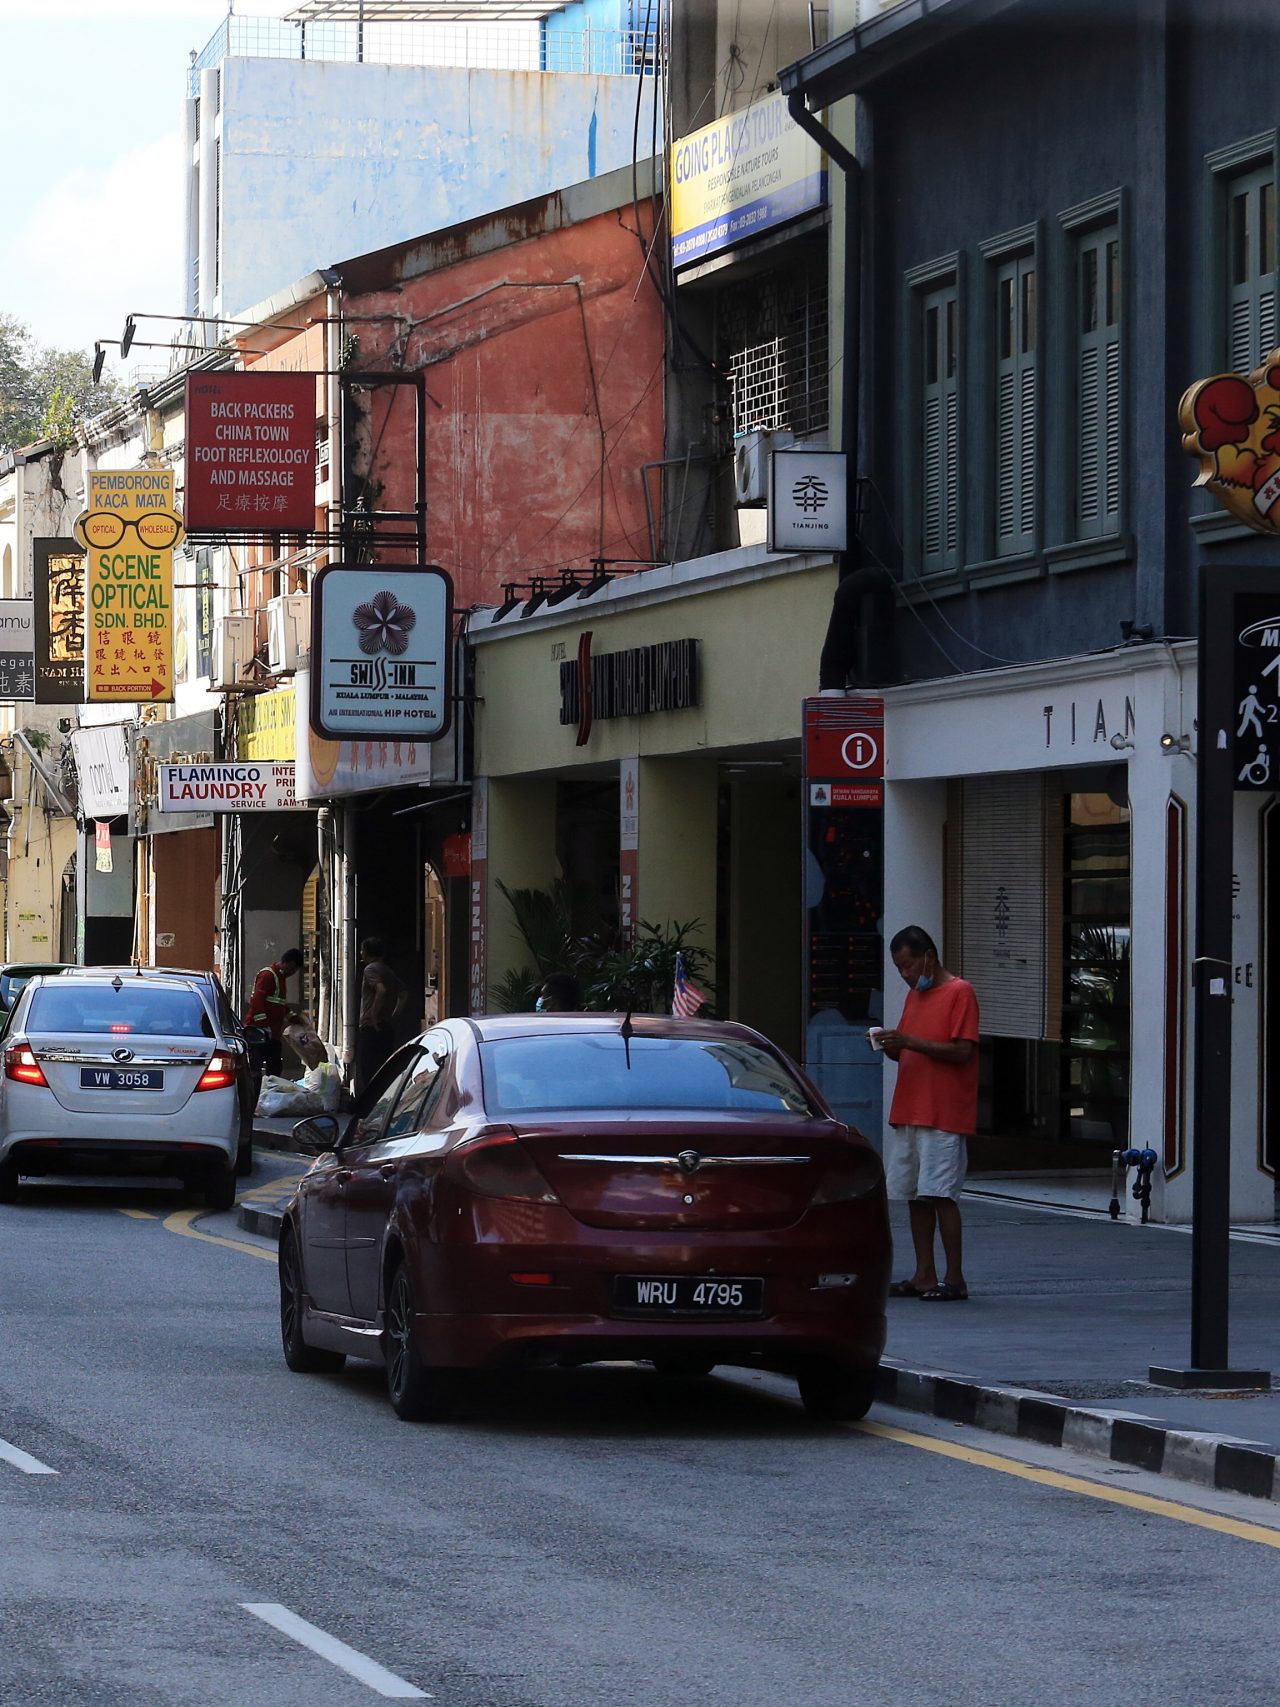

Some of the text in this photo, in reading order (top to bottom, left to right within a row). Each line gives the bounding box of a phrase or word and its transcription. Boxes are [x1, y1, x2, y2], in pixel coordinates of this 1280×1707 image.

[675, 99, 783, 184] GOING PLACES TOUR
[741, 156, 761, 177] NATURE
[211, 402, 294, 419] BACK PACKERS
[215, 425, 289, 441] CHINA TOWN
[195, 447, 309, 464] FOOT REFLEXOLOGY
[91, 475, 169, 490] PEMBORONG
[210, 469, 294, 486] AND MASSAGE
[95, 493, 166, 508] KACA MATA
[216, 493, 288, 512] 足療按摩
[92, 525, 116, 534] OPTICAL
[140, 525, 174, 534] WHOLESALE
[99, 553, 161, 580] SCENE
[91, 583, 169, 610] OPTICAL
[94, 612, 167, 629] SDN. BHD.
[40, 667, 67, 677] NAM
[360, 692, 389, 700] LUMPUR
[338, 709, 382, 717] INTERNATIONAL
[385, 709, 402, 717] HIP
[404, 710, 436, 718] HOTEL
[168, 767, 260, 782] FLAMINGO
[170, 783, 267, 799] LAUNDRY
[231, 800, 266, 808] SERVICE
[95, 1072, 149, 1085] VW 3058
[637, 1282, 743, 1306] WRU 4795
